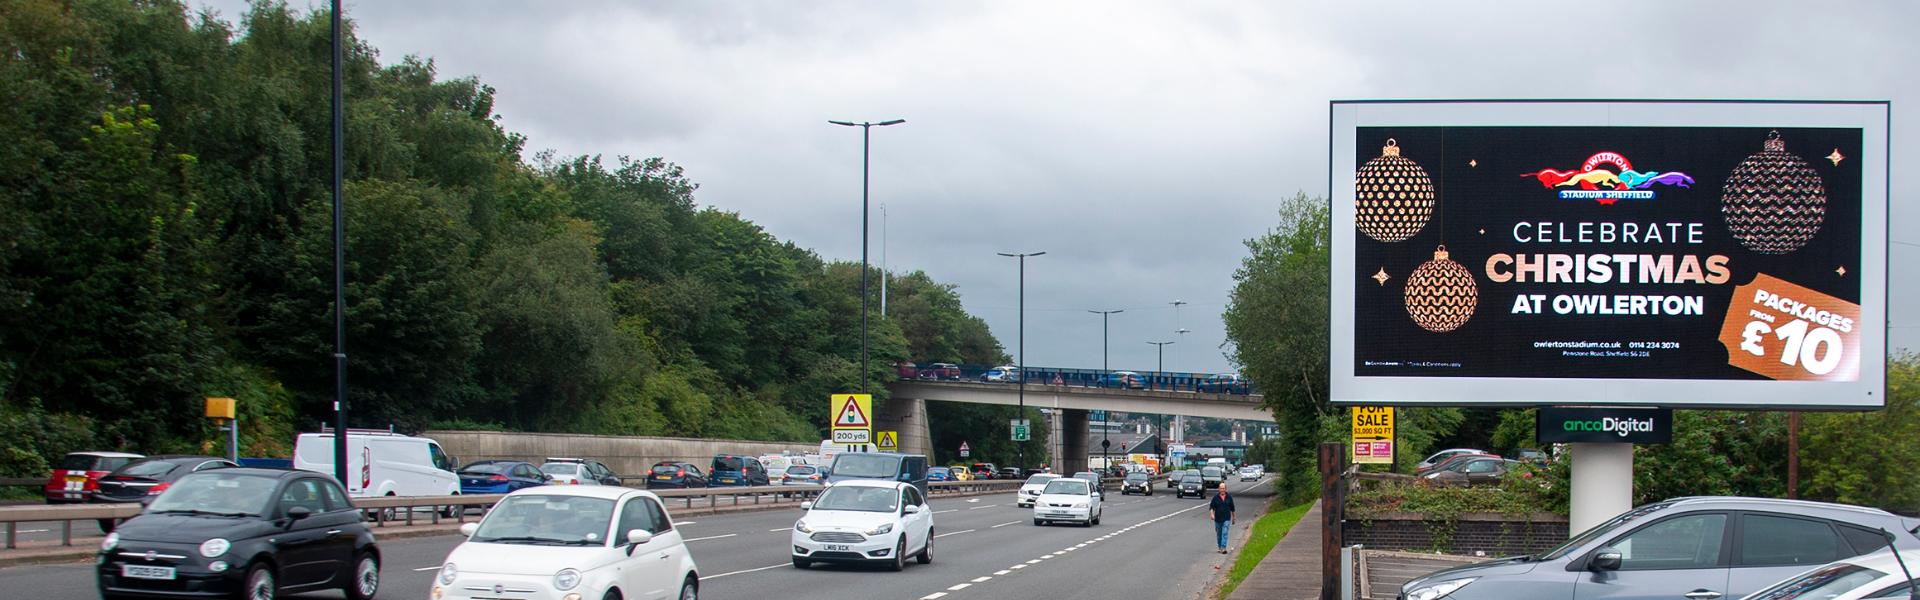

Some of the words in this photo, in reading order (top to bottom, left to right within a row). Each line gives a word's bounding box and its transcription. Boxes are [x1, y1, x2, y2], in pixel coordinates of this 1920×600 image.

[1584, 152, 1629, 172] OWLERTON
[1562, 190, 1603, 199] STADIUM
[1606, 190, 1654, 199] SHEFFIELD
[1513, 221, 1704, 244] CELEBRATE
[1485, 253, 1731, 284] CHRISTMAS
[1511, 294, 1546, 314] AT
[1552, 294, 1704, 316] OWLERTON
[1753, 289, 1854, 333] PACKAGES
[1749, 309, 1776, 323] FROM
[1533, 340, 1622, 349] owlertonstadium.co.uk
[1629, 341, 1645, 349] 0114
[1740, 318, 1843, 375] £10
[1357, 414, 1389, 427] SALE
[1563, 417, 1654, 437] ancoDigital
[836, 432, 852, 440] 200
[854, 432, 867, 441] yds
[1374, 427, 1383, 435] SQ
